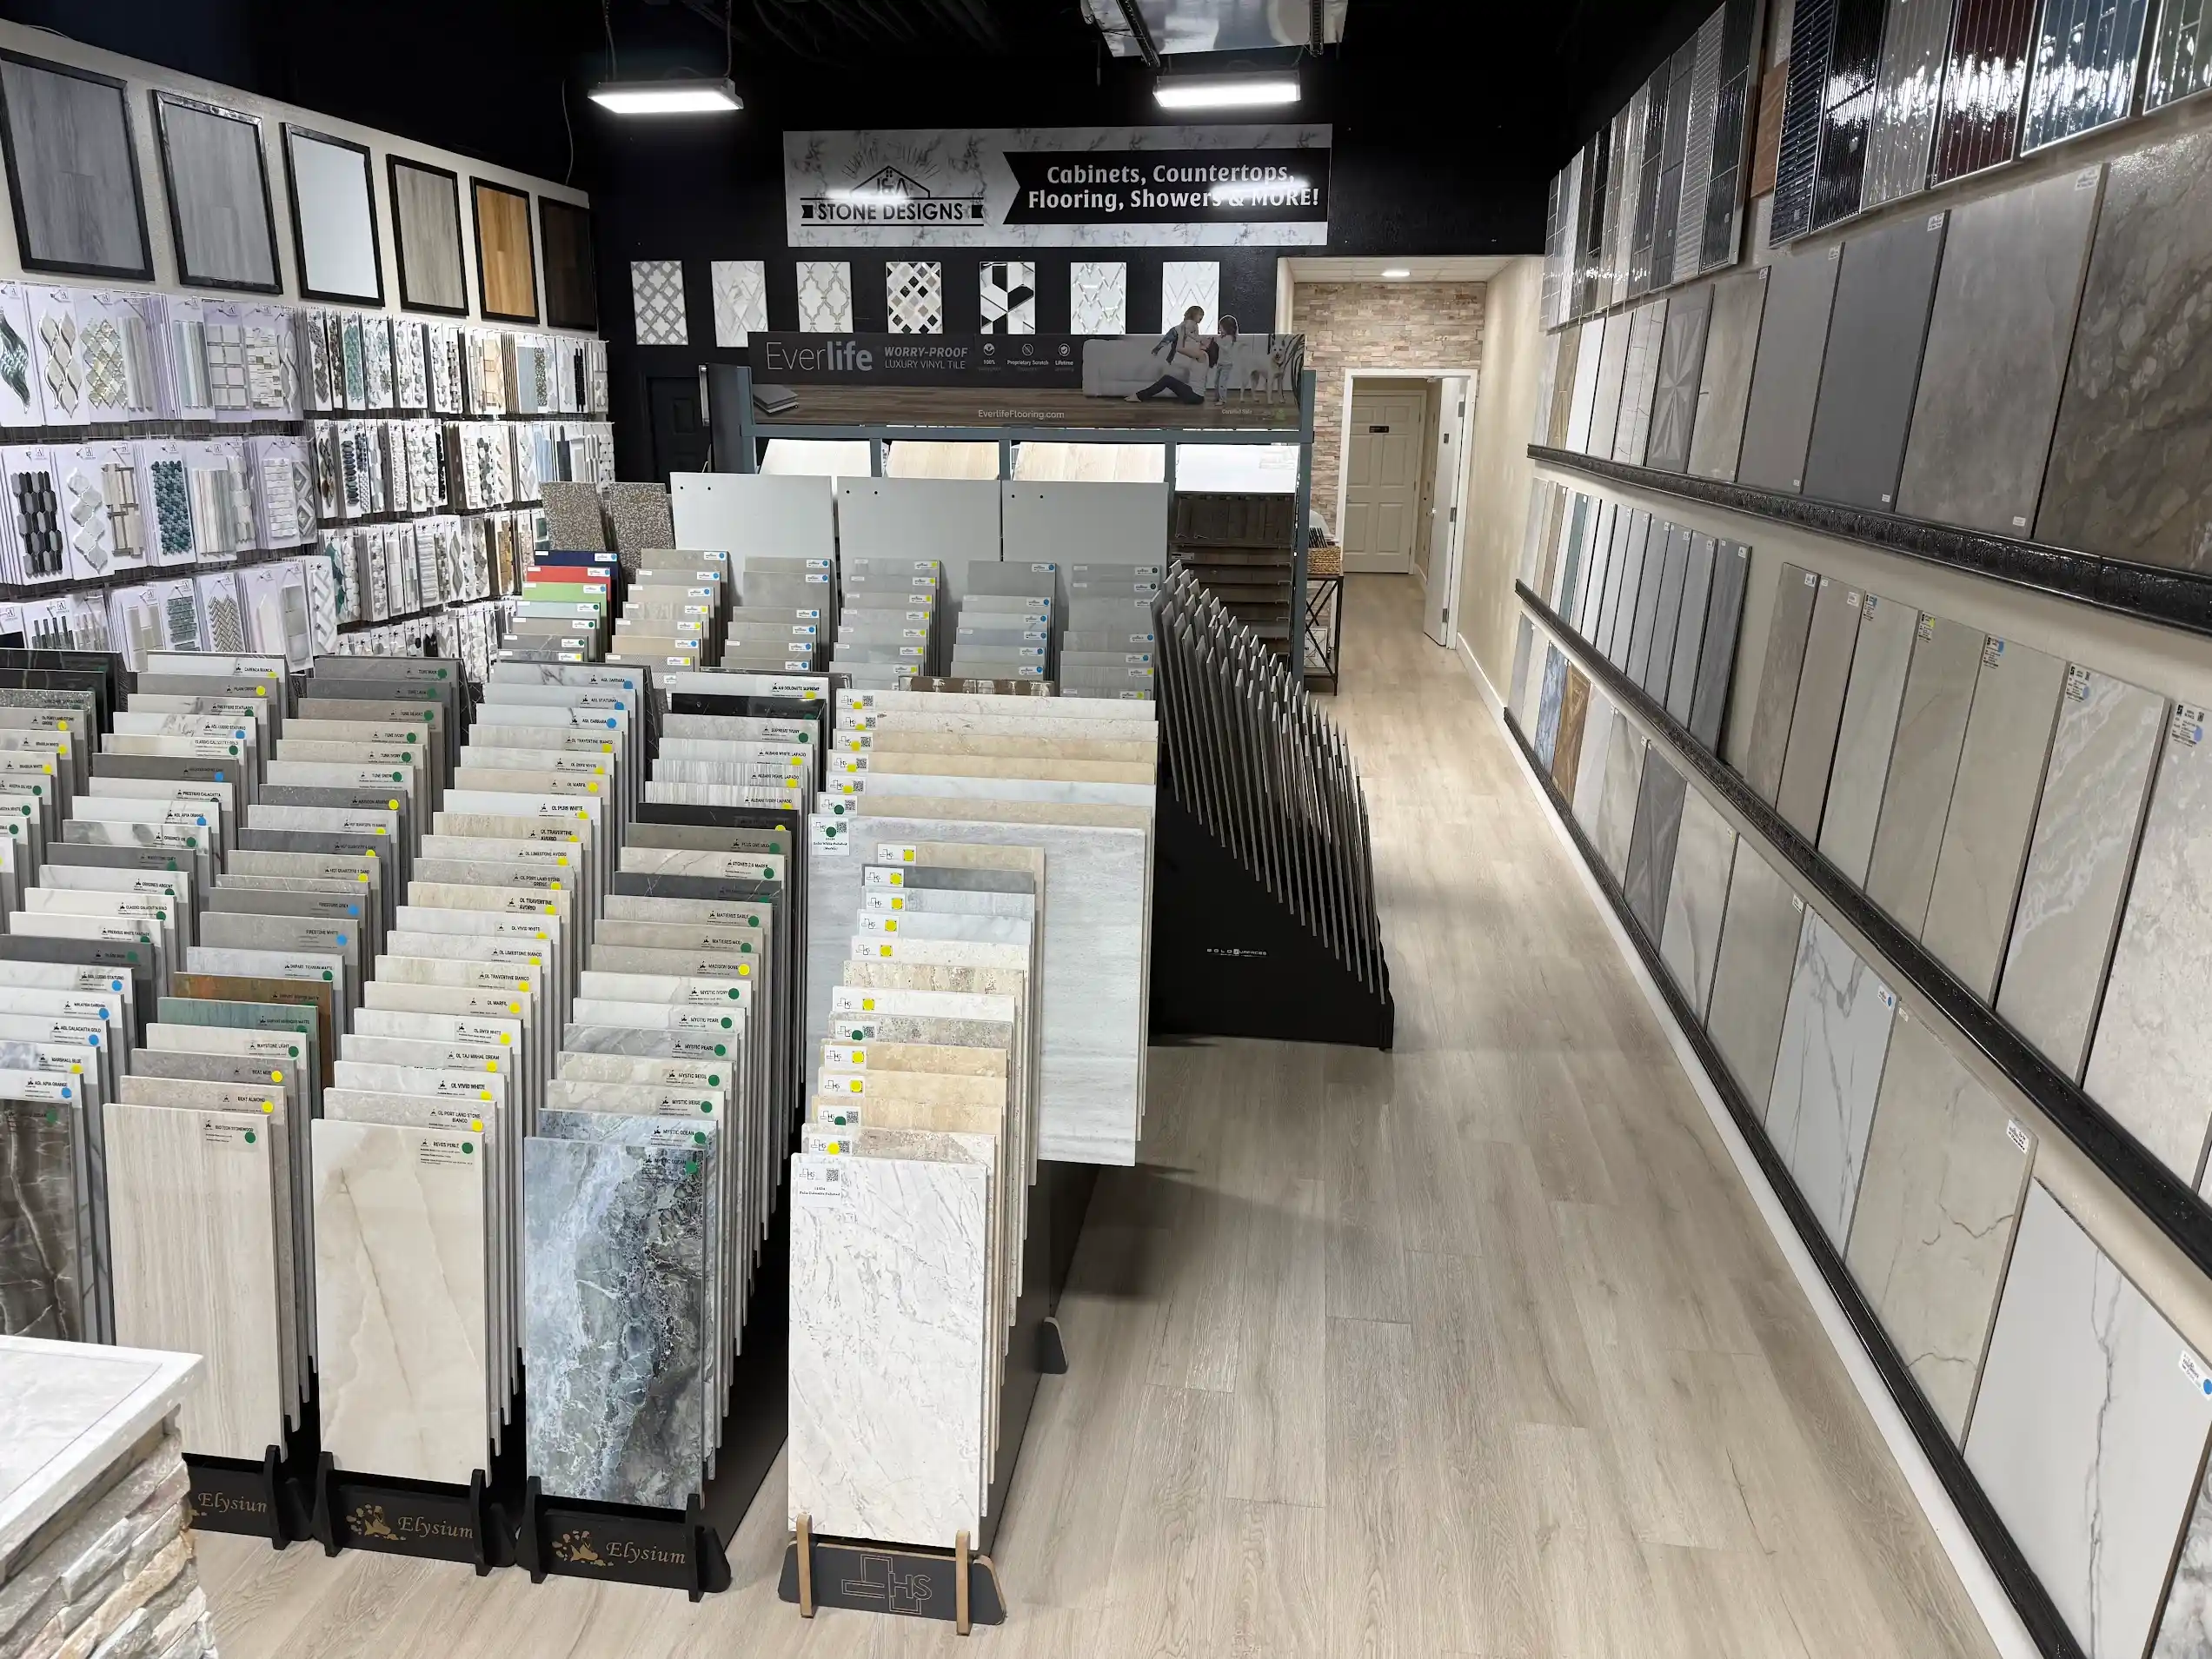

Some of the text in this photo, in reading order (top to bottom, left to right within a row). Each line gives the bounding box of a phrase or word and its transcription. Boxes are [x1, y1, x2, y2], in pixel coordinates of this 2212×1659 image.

[1046, 163, 1295, 187] Cabinets, Countertops,
[817, 202, 963, 221] STONE DESIGNS
[1028, 189, 1124, 213] Flooring,
[1130, 189, 1222, 208] Showers
[1252, 188, 1319, 207] MORE!
[766, 341, 874, 371] Everlife
[884, 346, 968, 358] WORRY-PROOF
[885, 359, 918, 369] LUXURY
[920, 360, 946, 369] VINYL
[948, 360, 966, 369] TILE
[978, 409, 1065, 420] EverlifeFlooring.com
[197, 1492, 268, 1514] Elysium
[397, 1516, 474, 1539] Elysium
[606, 1542, 686, 1564] Elysium
